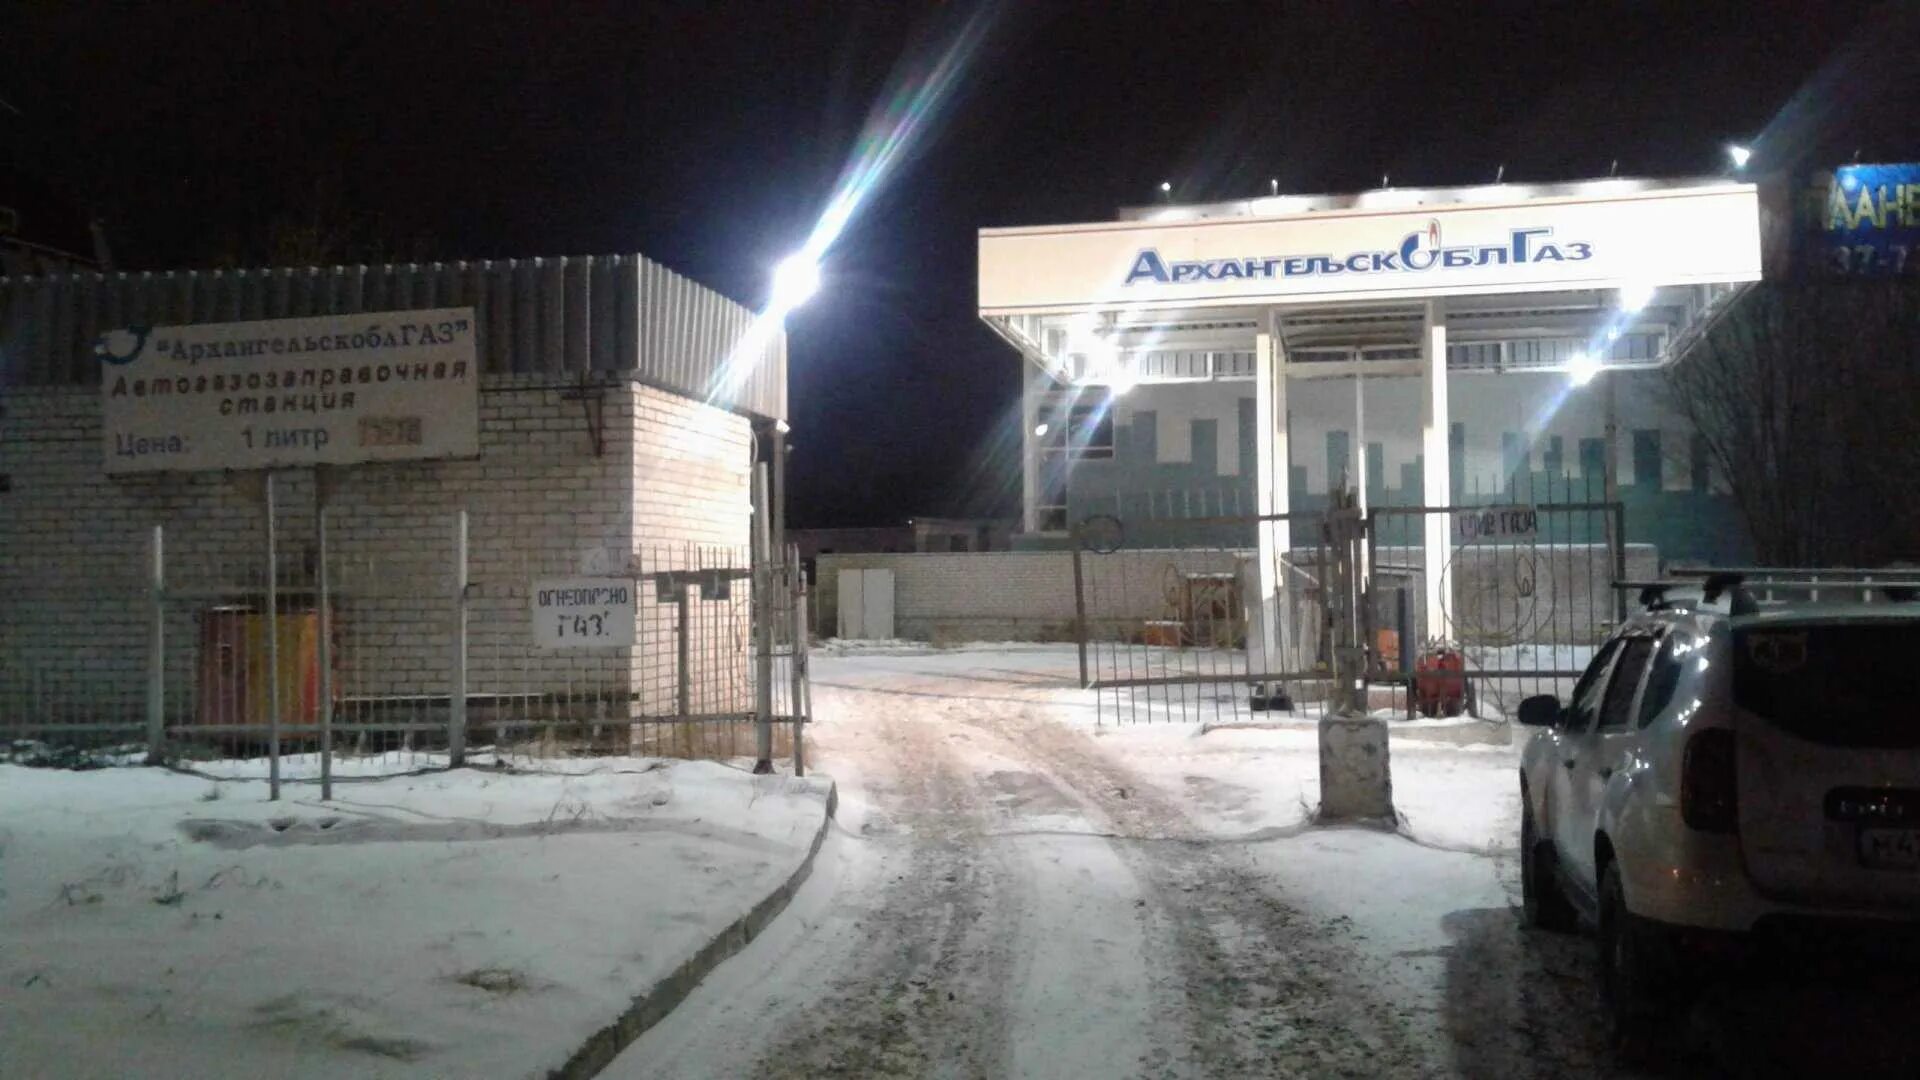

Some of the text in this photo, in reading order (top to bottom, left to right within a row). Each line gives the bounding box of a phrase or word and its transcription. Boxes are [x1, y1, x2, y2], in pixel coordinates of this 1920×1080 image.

[111, 360, 468, 397] Автогазозаправочная
[219, 391, 355, 416] станция
[241, 429, 254, 449] 1
[264, 427, 330, 452] литр
[538, 587, 628, 607] ОГНЕОПАСНО
